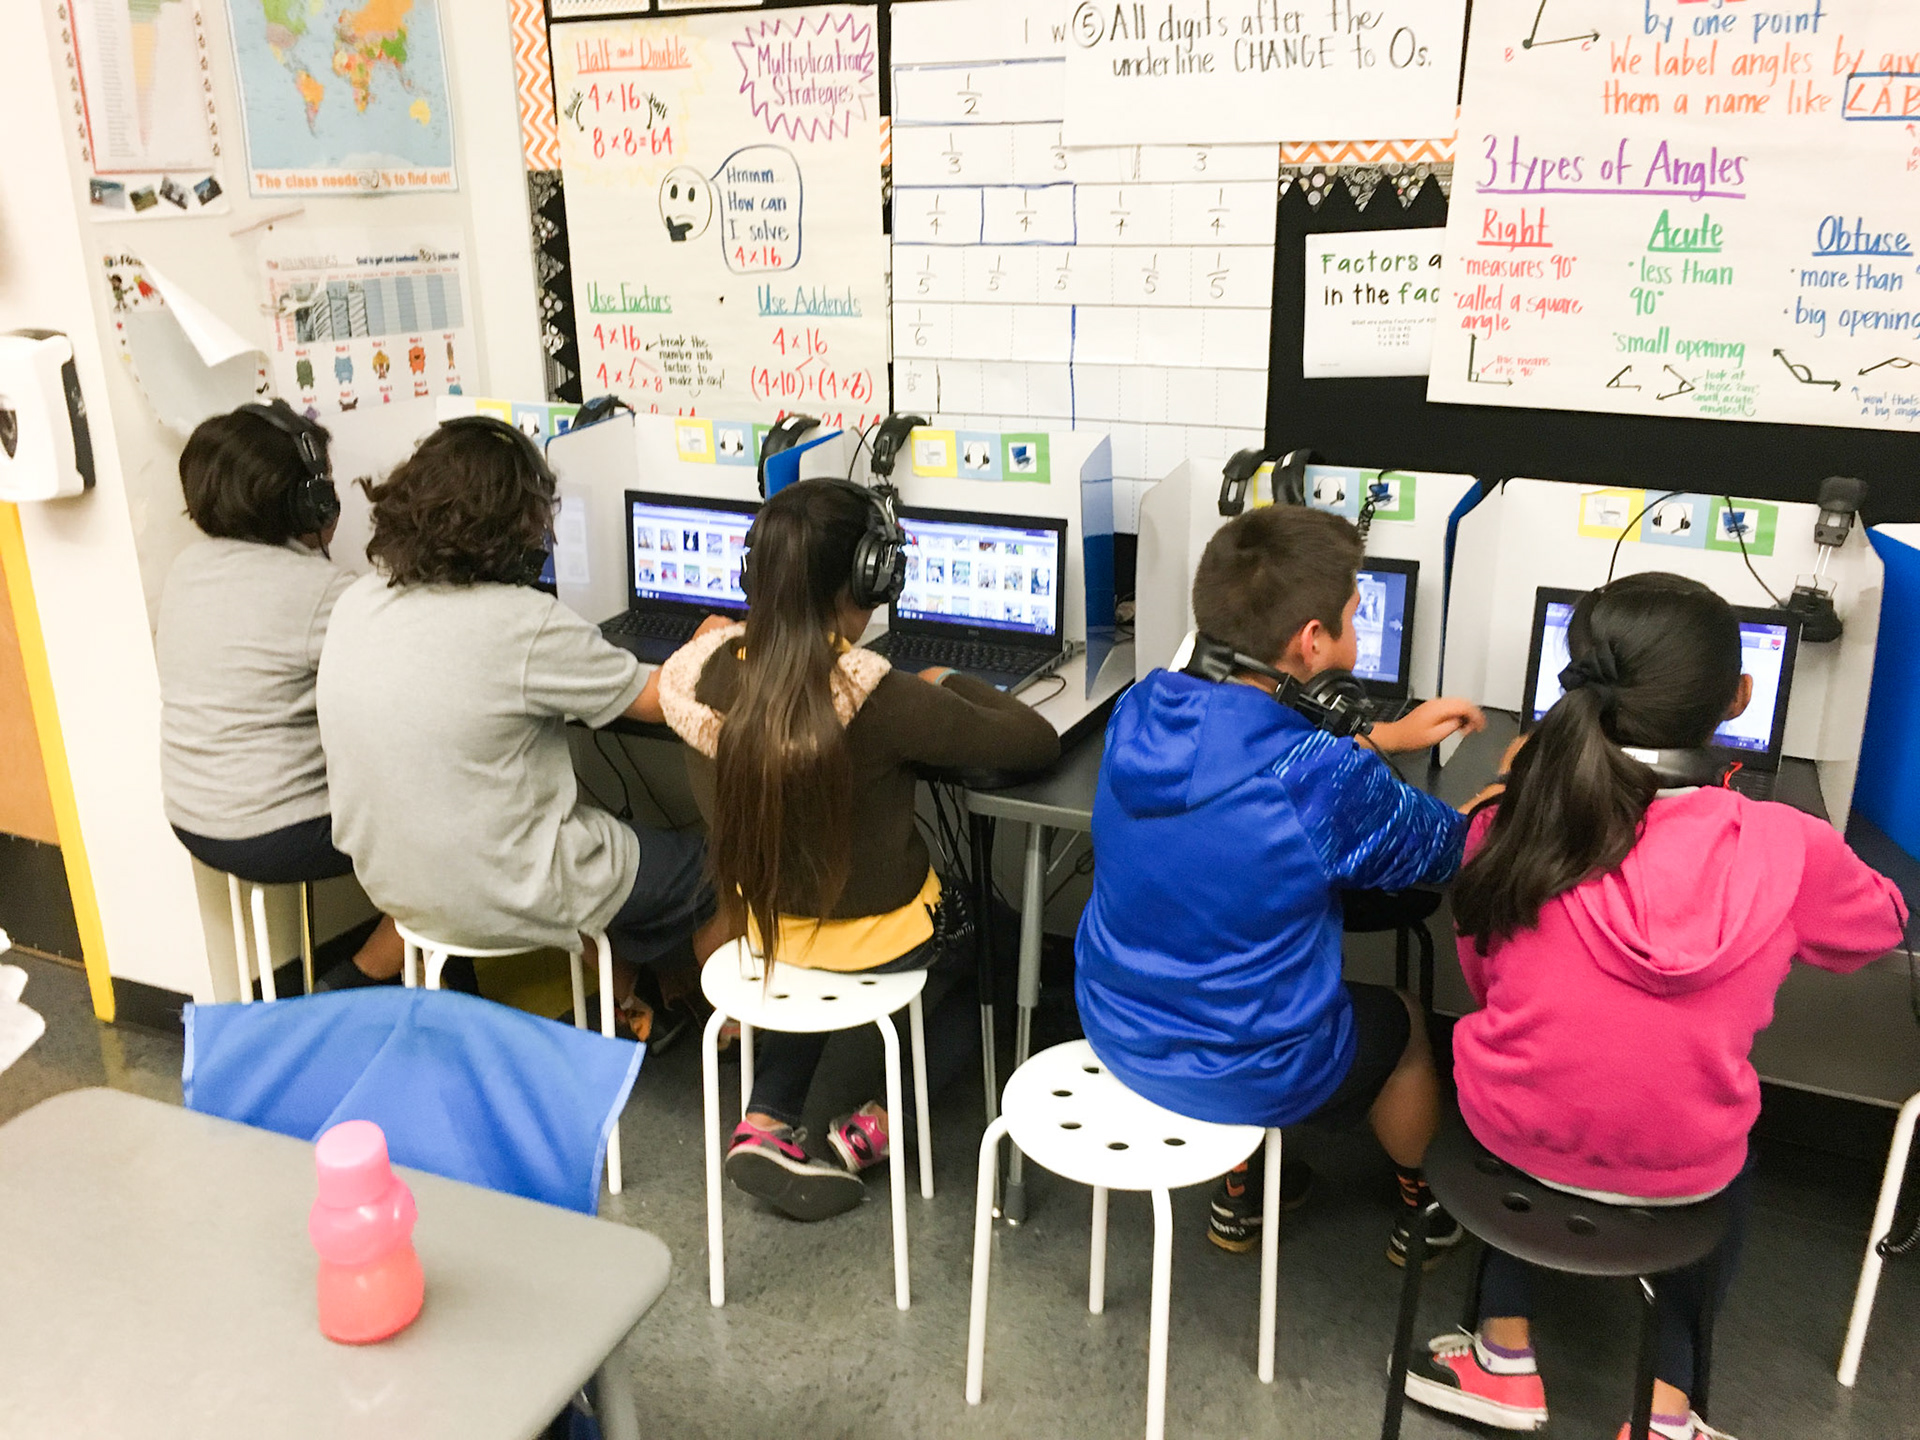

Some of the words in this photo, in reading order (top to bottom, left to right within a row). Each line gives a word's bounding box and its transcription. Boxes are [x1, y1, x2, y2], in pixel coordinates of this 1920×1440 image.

[1109, 3, 1146, 41] All
[1158, 0, 1229, 54] digits
[1241, 0, 1304, 35] after
[1325, 0, 1384, 34] the
[1645, 0, 1674, 43] by
[1693, 13, 1737, 37] one
[1752, 0, 1828, 44] point
[576, 38, 611, 71] Half
[640, 35, 688, 69] Double
[758, 39, 864, 79] Multiplication
[1112, 44, 1215, 77] underline
[1234, 34, 1335, 73] CHANGE
[1351, 34, 1376, 69] to
[1610, 34, 1642, 74] We
[1655, 37, 1718, 77] label
[1731, 41, 1813, 87] angles
[1833, 34, 1864, 76] by
[772, 76, 853, 116] Strategies
[1603, 79, 1659, 115] them
[1673, 92, 1689, 114] a
[1705, 93, 1770, 115] name
[1788, 79, 1832, 115] like
[256, 174, 281, 188] The
[285, 174, 318, 188] class
[322, 173, 358, 187] needs
[395, 173, 405, 186] to
[408, 171, 428, 185] find
[1476, 135, 1497, 188] 3
[1508, 136, 1584, 191] types
[1600, 138, 1632, 185] of
[1645, 140, 1748, 202] Angles
[728, 190, 754, 211] How
[762, 197, 787, 211] can
[730, 219, 740, 240] I
[750, 219, 789, 240] solve
[1482, 207, 1549, 252] Right
[1648, 208, 1723, 247] Acute
[1817, 215, 1911, 252] Obtuse
[1321, 250, 1418, 274] Factors
[1466, 259, 1544, 279] measures
[1640, 256, 1672, 284] less
[1682, 259, 1733, 285] than
[1800, 269, 1850, 288] more
[1856, 264, 1903, 292] than
[587, 281, 616, 312] Use
[619, 281, 671, 312] Factors
[758, 283, 788, 315] Use
[794, 284, 861, 315] Addends
[1353, 282, 1390, 306] the
[1457, 283, 1504, 311] called
[1510, 294, 1521, 312] a
[1526, 295, 1583, 320] square
[1461, 313, 1511, 340] angle
[1795, 295, 1826, 338] big
[1616, 326, 1670, 354] small
[1675, 340, 1745, 369] opening
